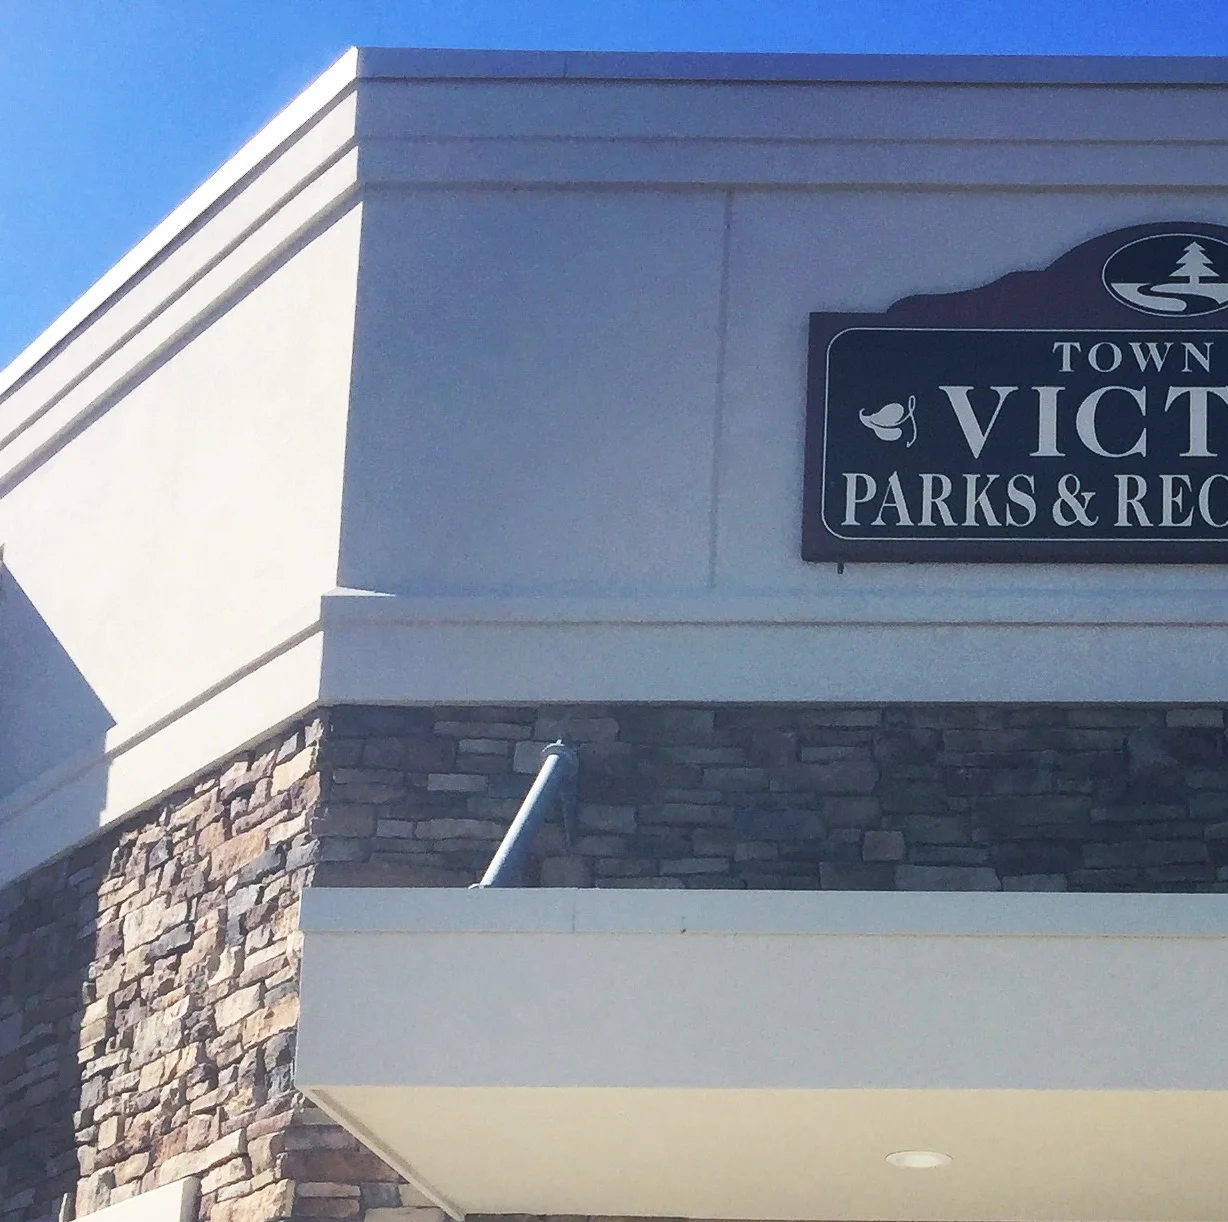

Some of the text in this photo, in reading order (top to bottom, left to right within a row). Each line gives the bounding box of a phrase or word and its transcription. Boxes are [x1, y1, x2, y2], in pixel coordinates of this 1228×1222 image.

[1053, 341, 1214, 373] TOWN
[841, 471, 1037, 527] PARKS
[1052, 473, 1099, 527] &
